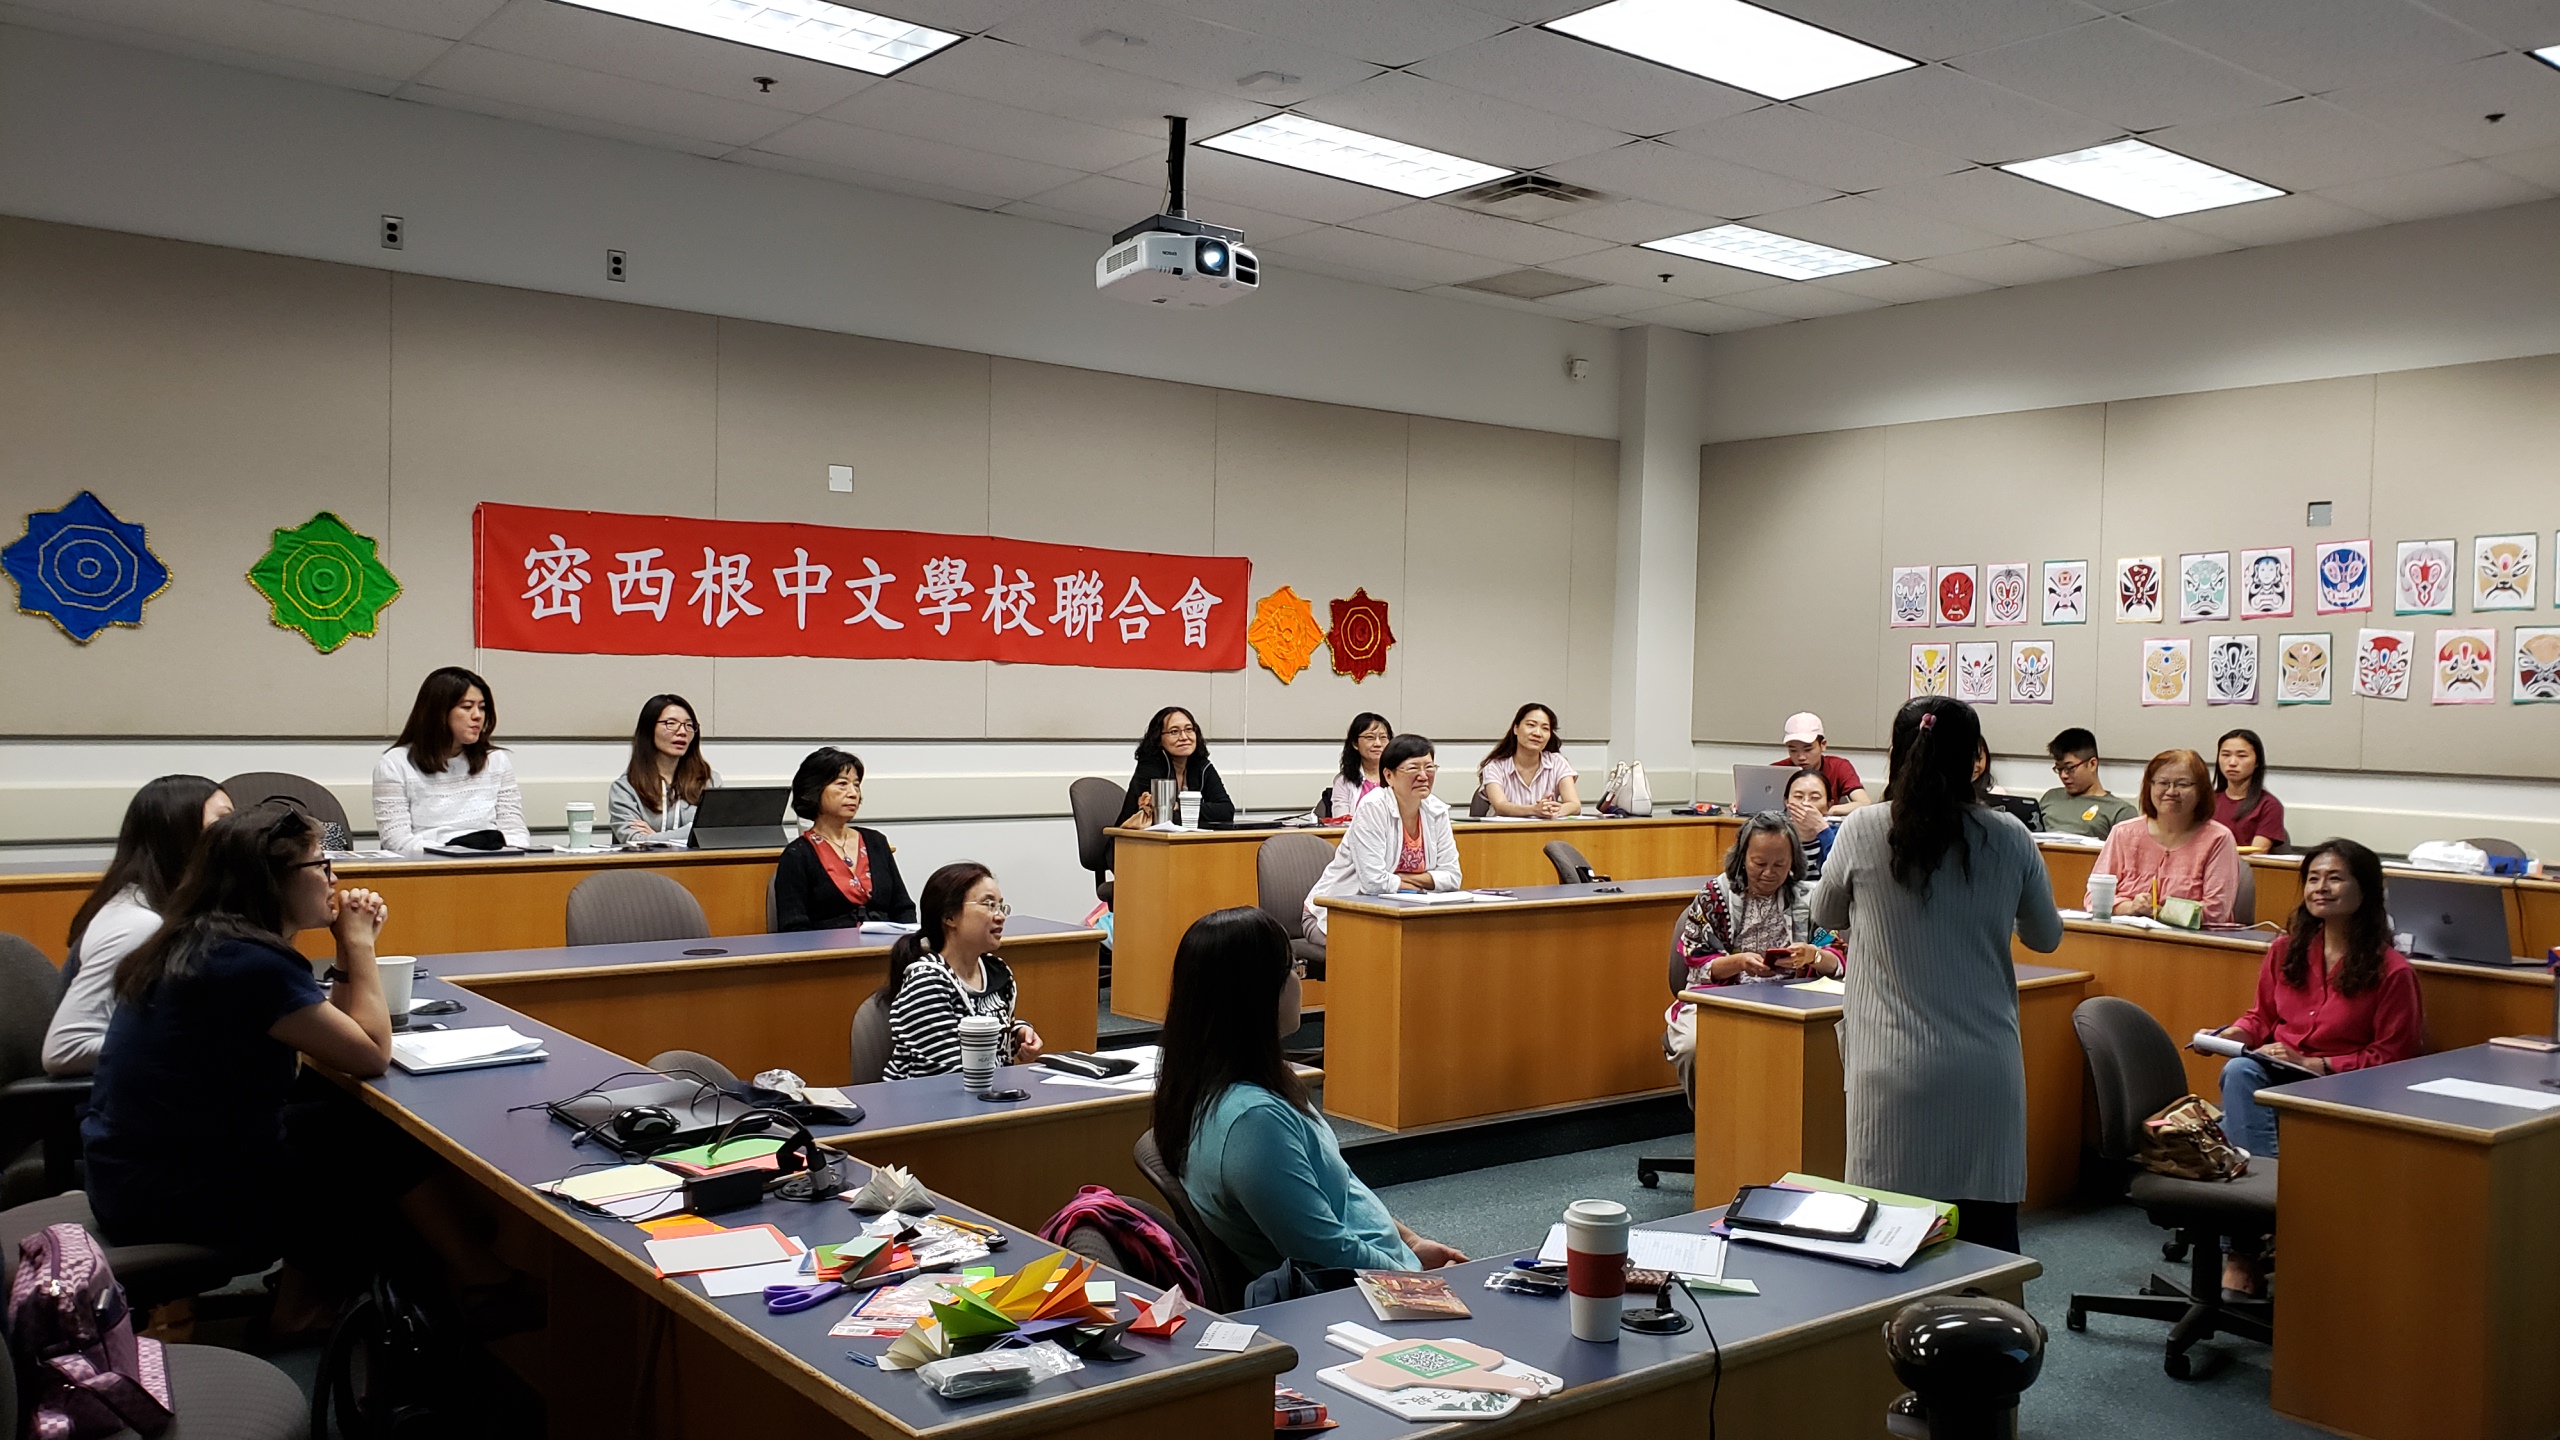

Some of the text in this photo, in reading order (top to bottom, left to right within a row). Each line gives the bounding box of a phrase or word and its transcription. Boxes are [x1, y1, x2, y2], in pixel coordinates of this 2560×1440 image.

[521, 533, 1223, 649] 密西根中文學校聯合會
